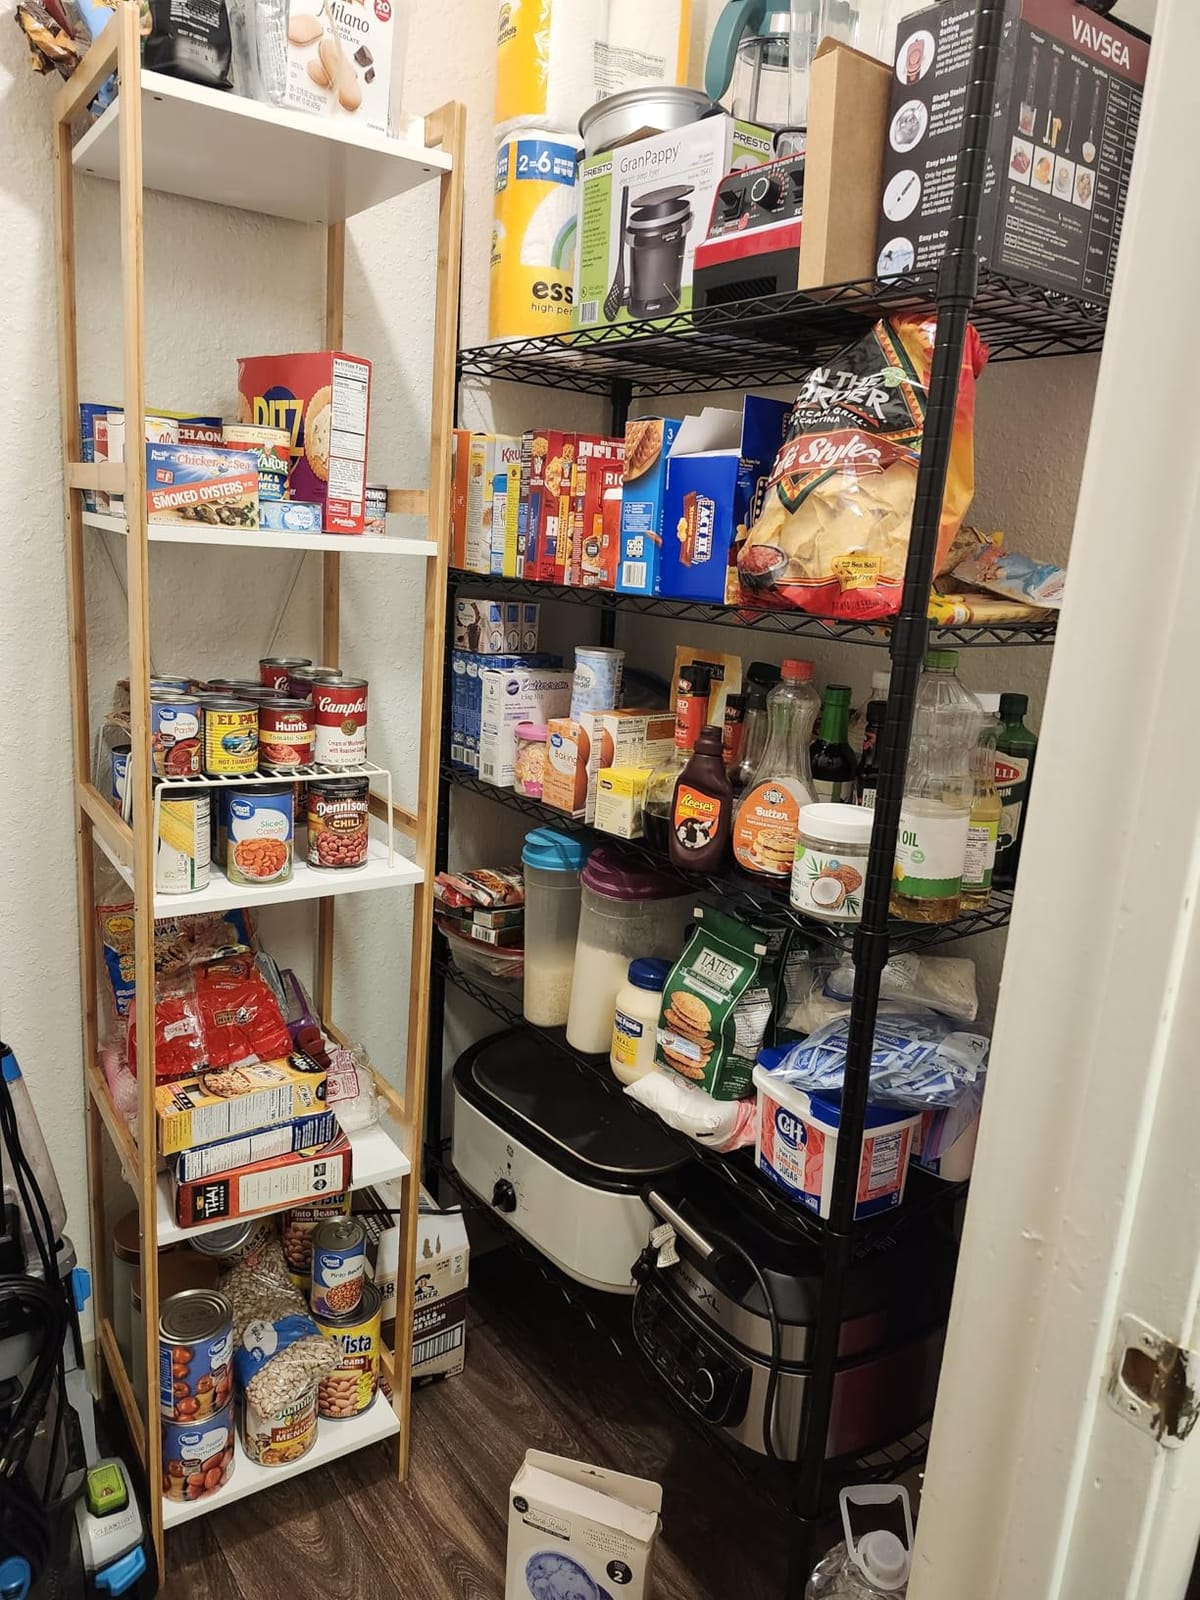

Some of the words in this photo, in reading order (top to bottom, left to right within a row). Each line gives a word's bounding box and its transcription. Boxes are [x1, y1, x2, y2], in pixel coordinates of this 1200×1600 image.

[316, 2, 370, 33] Milano
[1071, 14, 1130, 71] VAVSEA
[733, 131, 771, 151] PRESTO
[620, 145, 679, 174] GranPappy
[584, 162, 613, 178] PRESTO
[531, 303, 553, 314] high
[836, 370, 884, 389] THE
[797, 383, 890, 420] ORDER
[667, 428, 674, 440] 3
[798, 434, 882, 468] Style
[176, 453, 218, 467] Chicken
[233, 459, 251, 470] Sea
[153, 489, 198, 509] SMOKED
[199, 480, 244, 501] OYSTERS
[699, 506, 710, 534] ACT
[217, 714, 236, 726] EL
[275, 719, 308, 731] Hunt's
[173, 726, 196, 735] Paste
[270, 733, 294, 742] Tomato
[218, 758, 230, 766] HOT
[554, 751, 578, 768] Baking
[231, 802, 251, 812] Great
[316, 799, 369, 817] Dennison's
[681, 793, 715, 812] Reese's
[754, 806, 788, 821] Butter
[256, 828, 284, 836] Carrots
[260, 819, 284, 829] Sliced
[332, 820, 359, 828] CHILI
[902, 830, 919, 848] OIL
[700, 951, 738, 981] TATE'S
[778, 1163, 798, 1184] SUGAR
[205, 1186, 219, 1218] THAI
[313, 1208, 339, 1218] Beans
[330, 1271, 347, 1279] Pinto
[424, 1315, 447, 1329] SUGAR
[613, 1570, 624, 1583] 2
